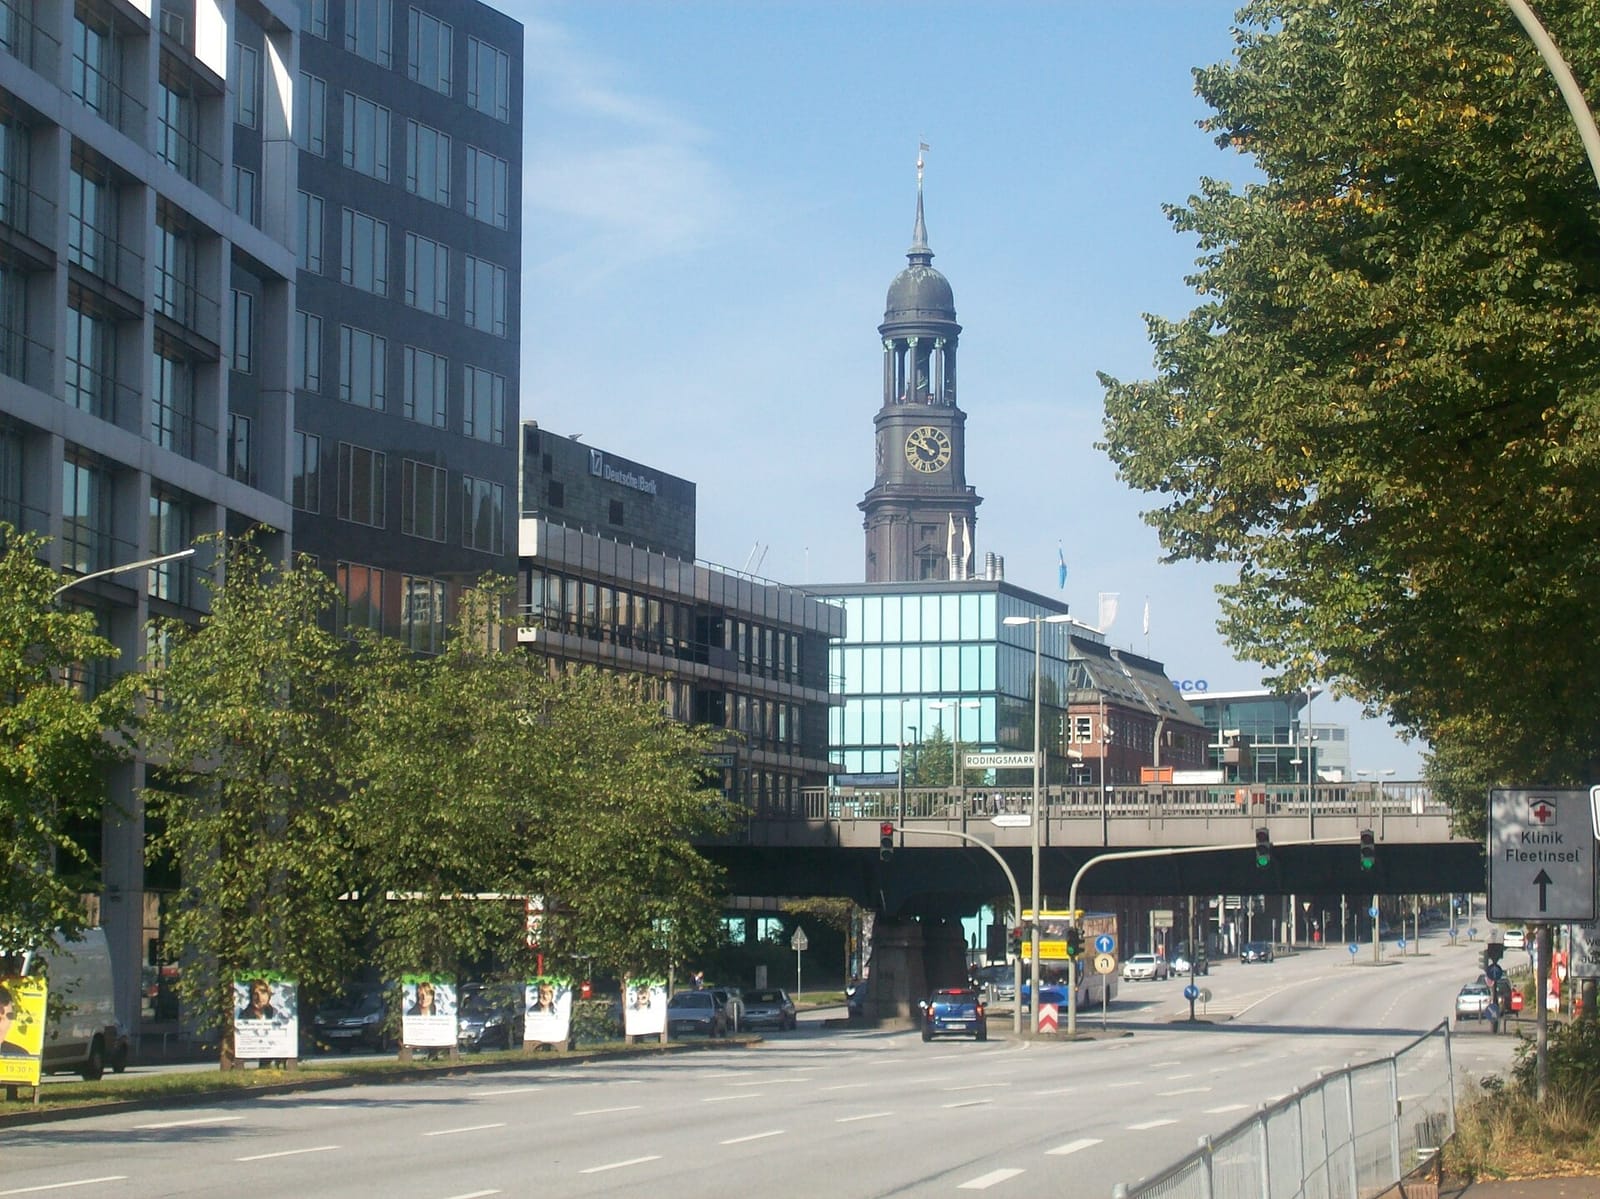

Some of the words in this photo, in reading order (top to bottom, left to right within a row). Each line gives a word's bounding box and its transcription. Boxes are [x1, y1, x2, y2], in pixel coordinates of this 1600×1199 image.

[604, 464, 637, 489] Deutsche
[638, 475, 656, 495] Bank
[1521, 831, 1564, 844] Klinik
[1505, 849, 1580, 862] Fleetinsel
